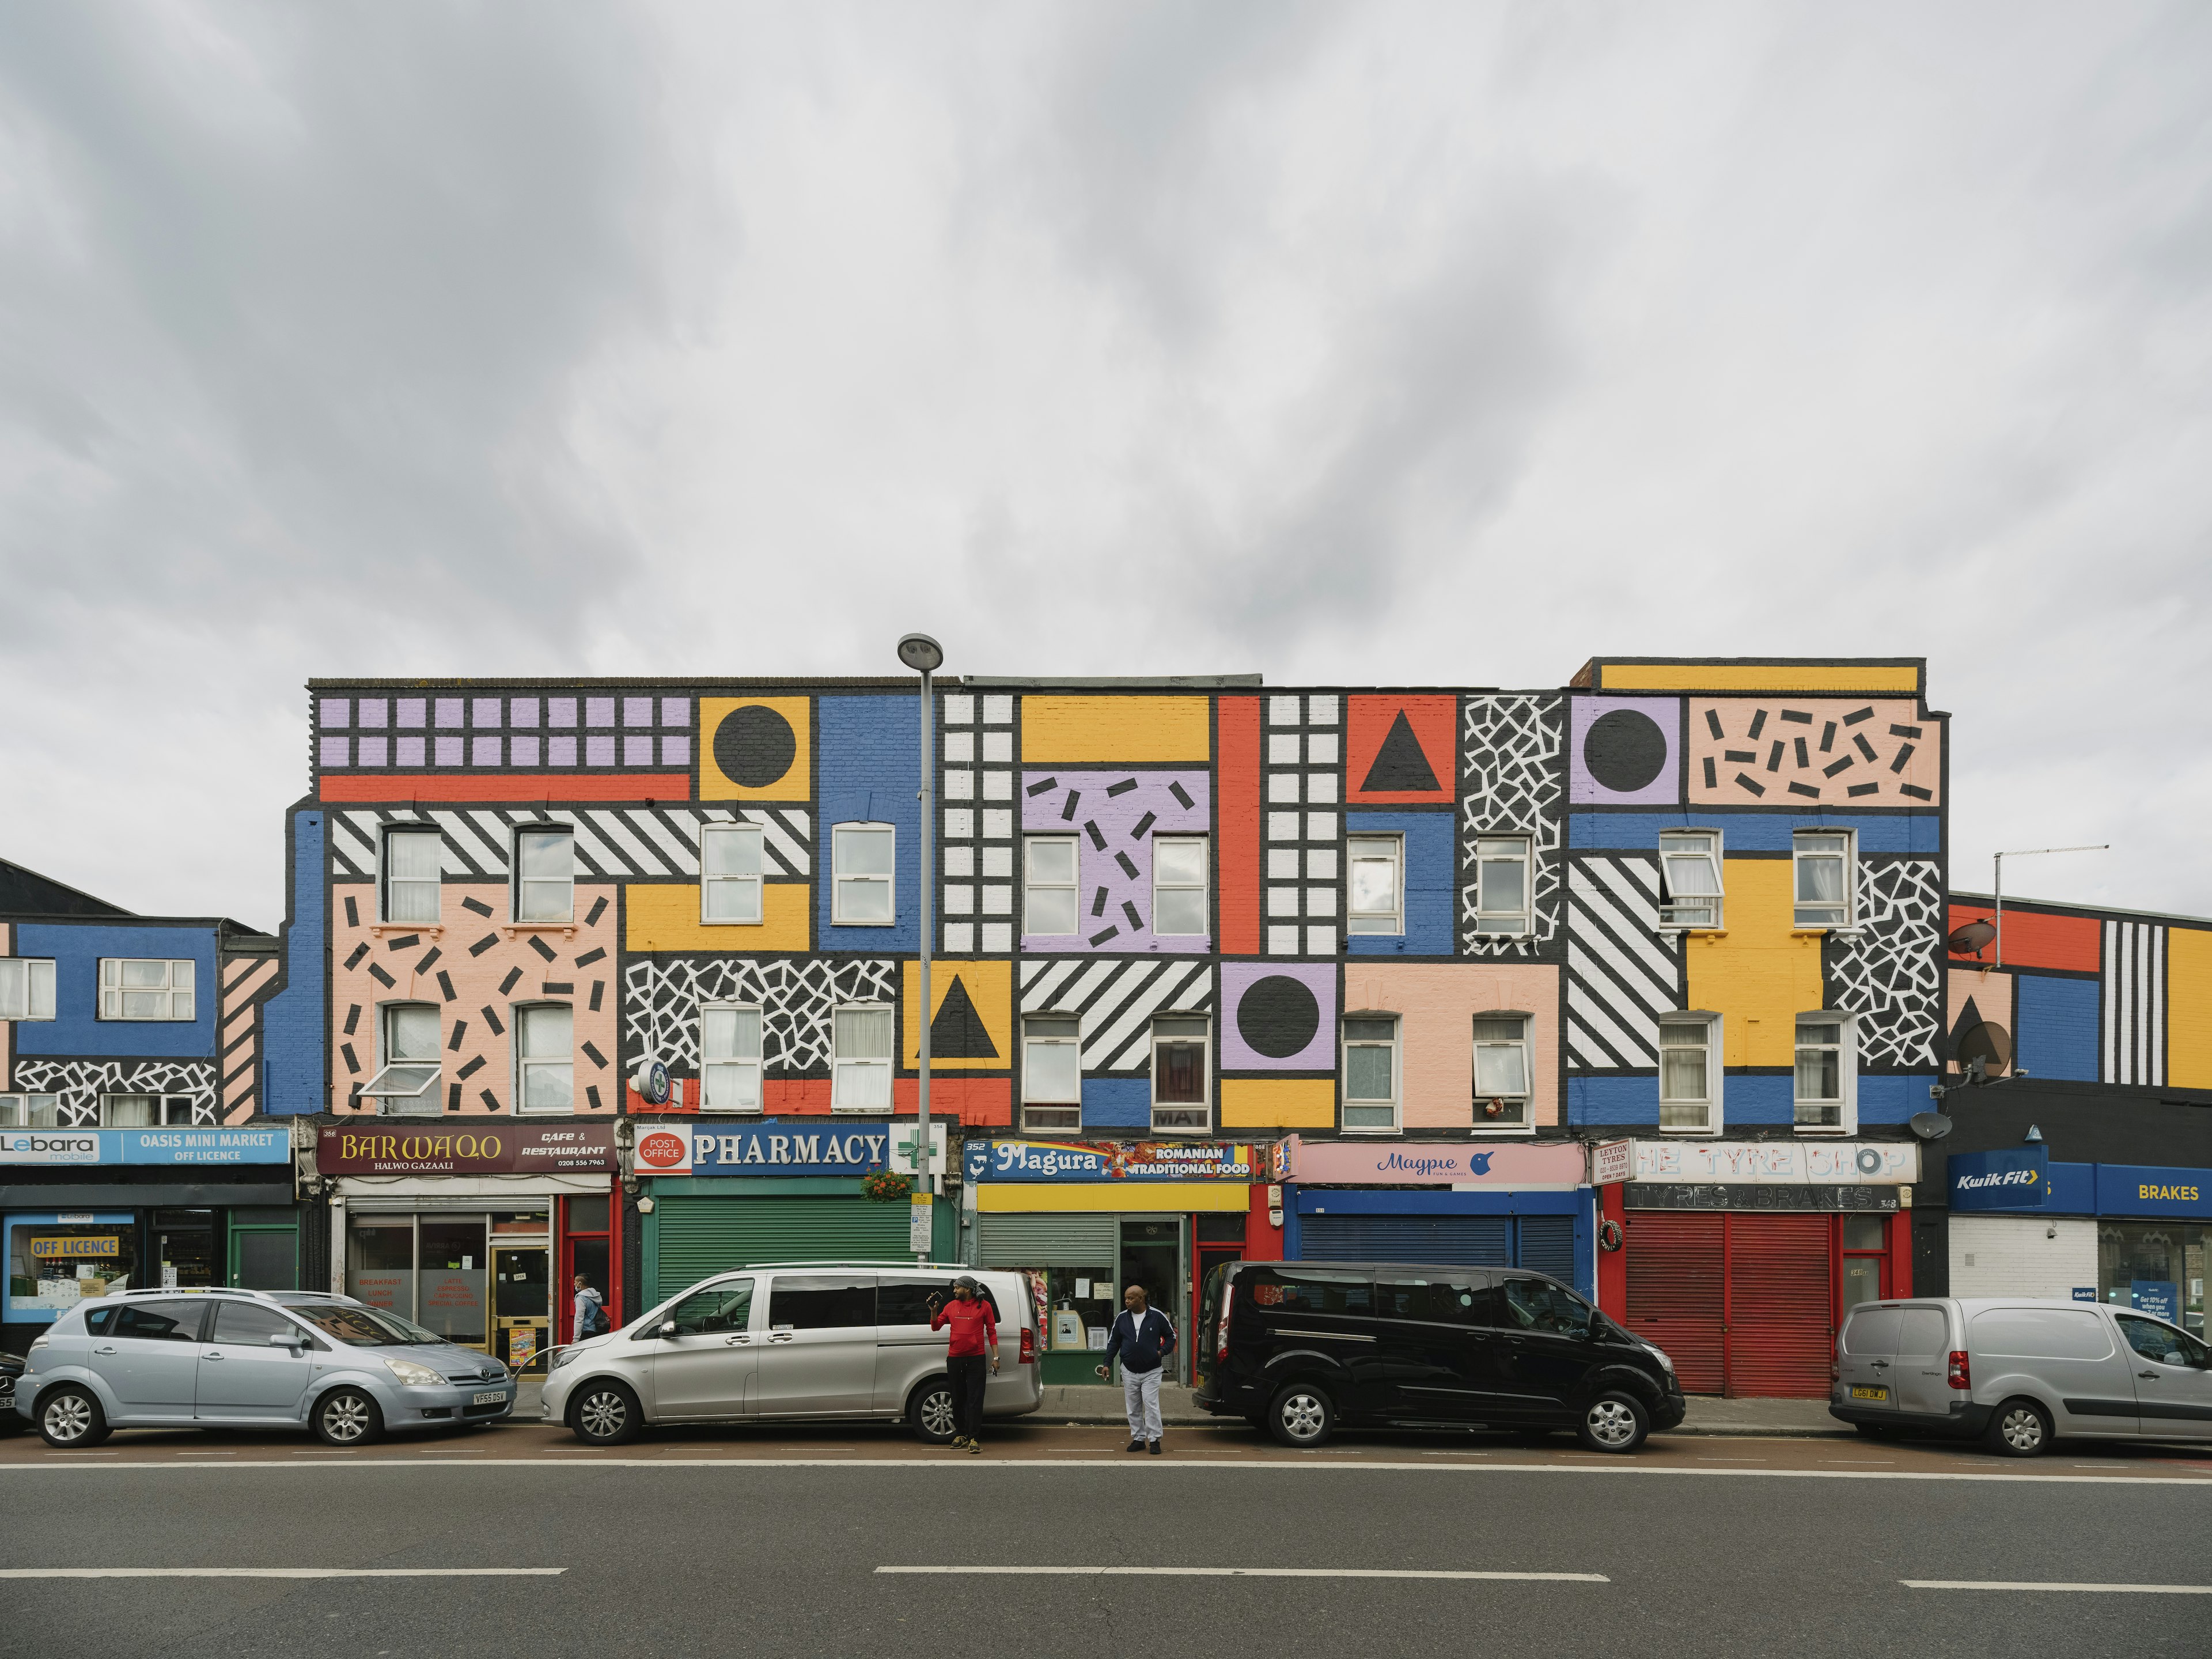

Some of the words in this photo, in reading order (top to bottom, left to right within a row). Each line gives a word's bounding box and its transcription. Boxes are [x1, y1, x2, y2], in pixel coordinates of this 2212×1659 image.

[140, 1134, 182, 1147] OASIS
[185, 1134, 215, 1147] MINI
[219, 1134, 274, 1146] MARKET
[579, 1132, 585, 1141] &
[0, 1135, 94, 1152] Lebara
[339, 1134, 502, 1161] BARWAQO
[650, 1139, 676, 1148] POST
[694, 1134, 887, 1165] PHARMACY
[175, 1152, 195, 1161] OFF
[197, 1151, 241, 1160] LICENCE
[643, 1149, 679, 1158] OFFICE
[1156, 1148, 1224, 1159] ROMANIAN
[1600, 1144, 1627, 1157] LEYTON
[997, 1143, 1098, 1176] Magura
[1377, 1153, 1457, 1176] Magpie
[1602, 1153, 1625, 1165] TYRES
[1699, 1149, 1793, 1176] TYRE
[1134, 1164, 1214, 1174] TRADITIONAL
[1216, 1164, 1250, 1174] FOOD
[1631, 1185, 1728, 1207] TYRES
[1734, 1188, 1749, 1207] &
[1754, 1186, 1872, 1208] BRAKES
[2139, 1184, 2199, 1200] BRAKES
[1879, 1199, 1897, 1209] 348
[33, 1241, 58, 1255] OFF
[63, 1240, 116, 1253] LICENCE
[476, 1394, 492, 1403] VF55
[493, 1392, 504, 1401] DSV
[1854, 1389, 1868, 1397] LG61
[1869, 1391, 1883, 1399] DWJ
